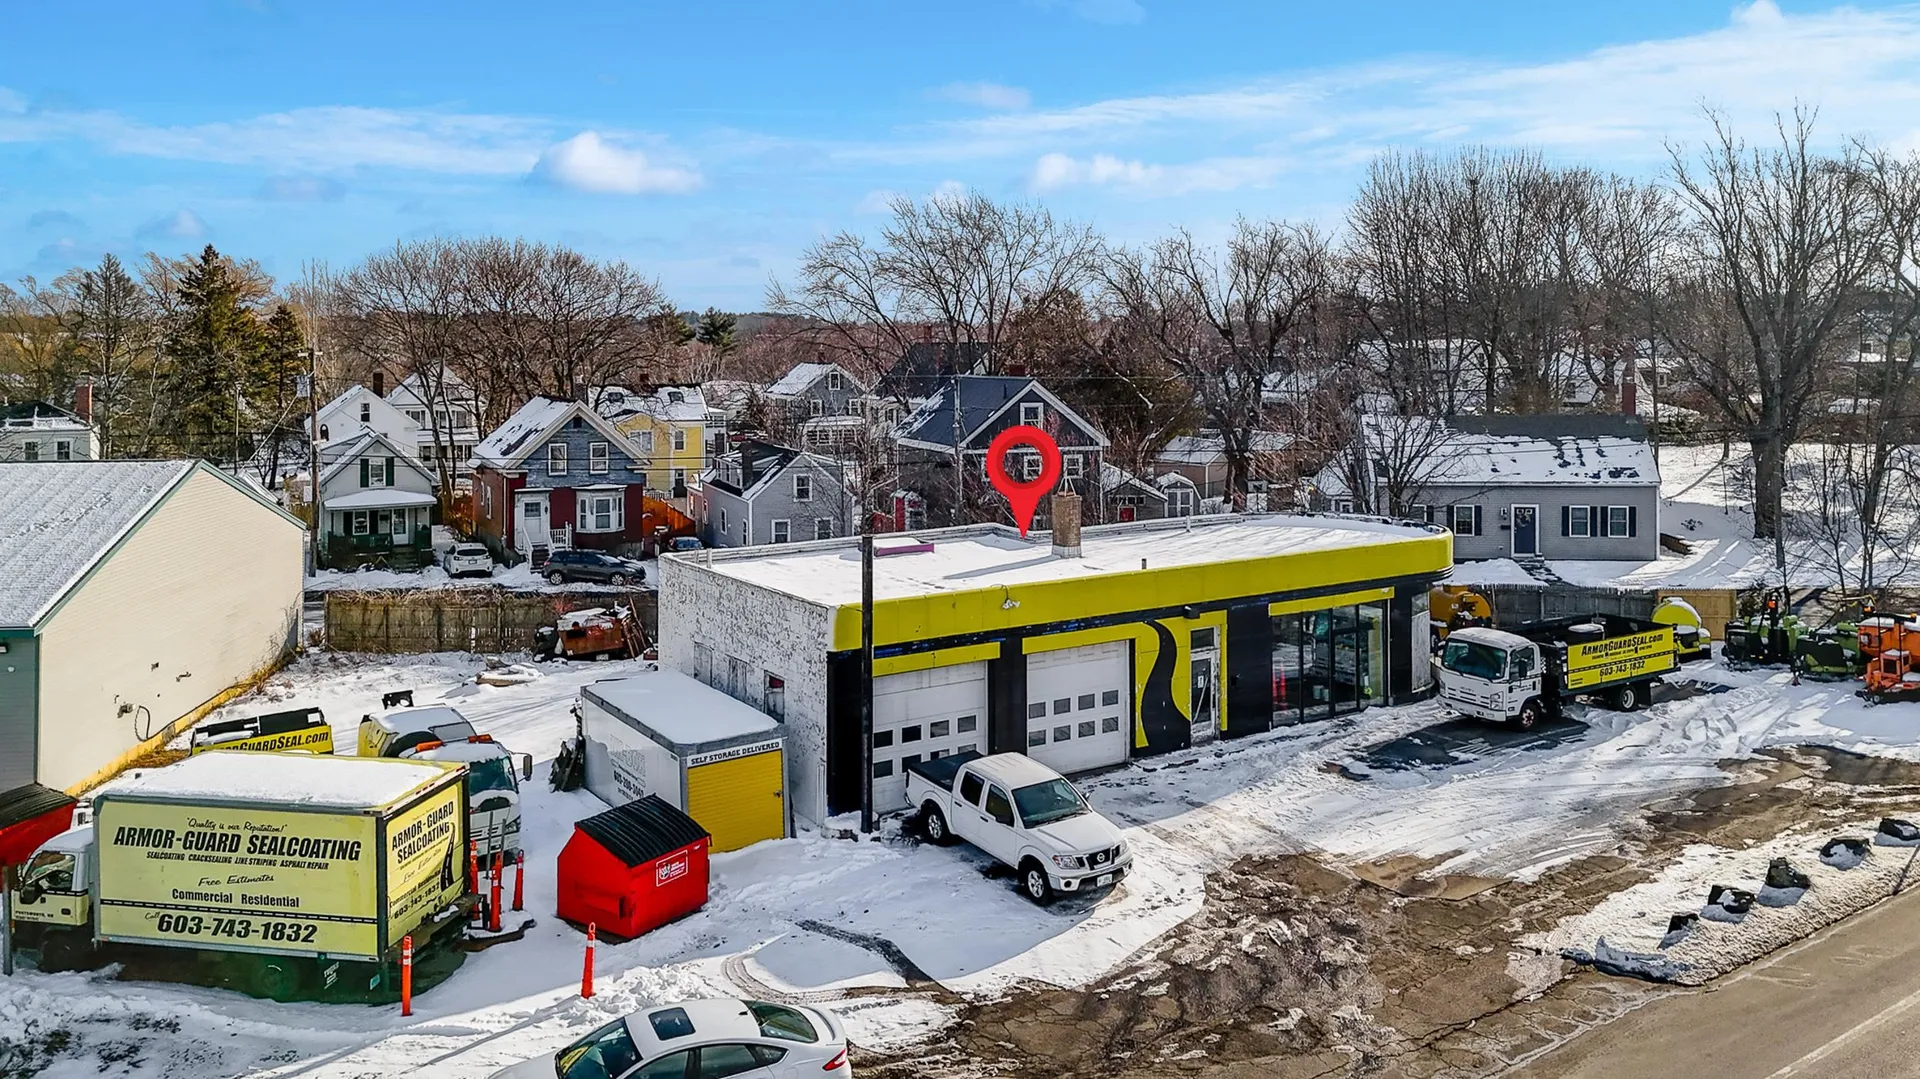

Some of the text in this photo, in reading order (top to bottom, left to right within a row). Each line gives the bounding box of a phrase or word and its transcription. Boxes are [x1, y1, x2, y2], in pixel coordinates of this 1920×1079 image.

[1599, 660, 1645, 677] 603-743-1832
[690, 757, 707, 766] SELF
[709, 749, 741, 761] STORAGE
[742, 741, 780, 755] DELIVERED
[392, 801, 454, 851] ARMOR-GUARD
[113, 826, 362, 861] ARMOR-GUARD SEALCOATING
[397, 821, 450, 864] SEALCOATING
[146, 850, 330, 870] SEALCOATING CRACKSEALING LINE STRIPING ASPHALT REPAIR
[198, 874, 275, 887] Free Estimates
[172, 888, 300, 908] Commercial Residential
[394, 882, 440, 919] 603-743-1832
[144, 911, 318, 943] Call 603-743-1832
